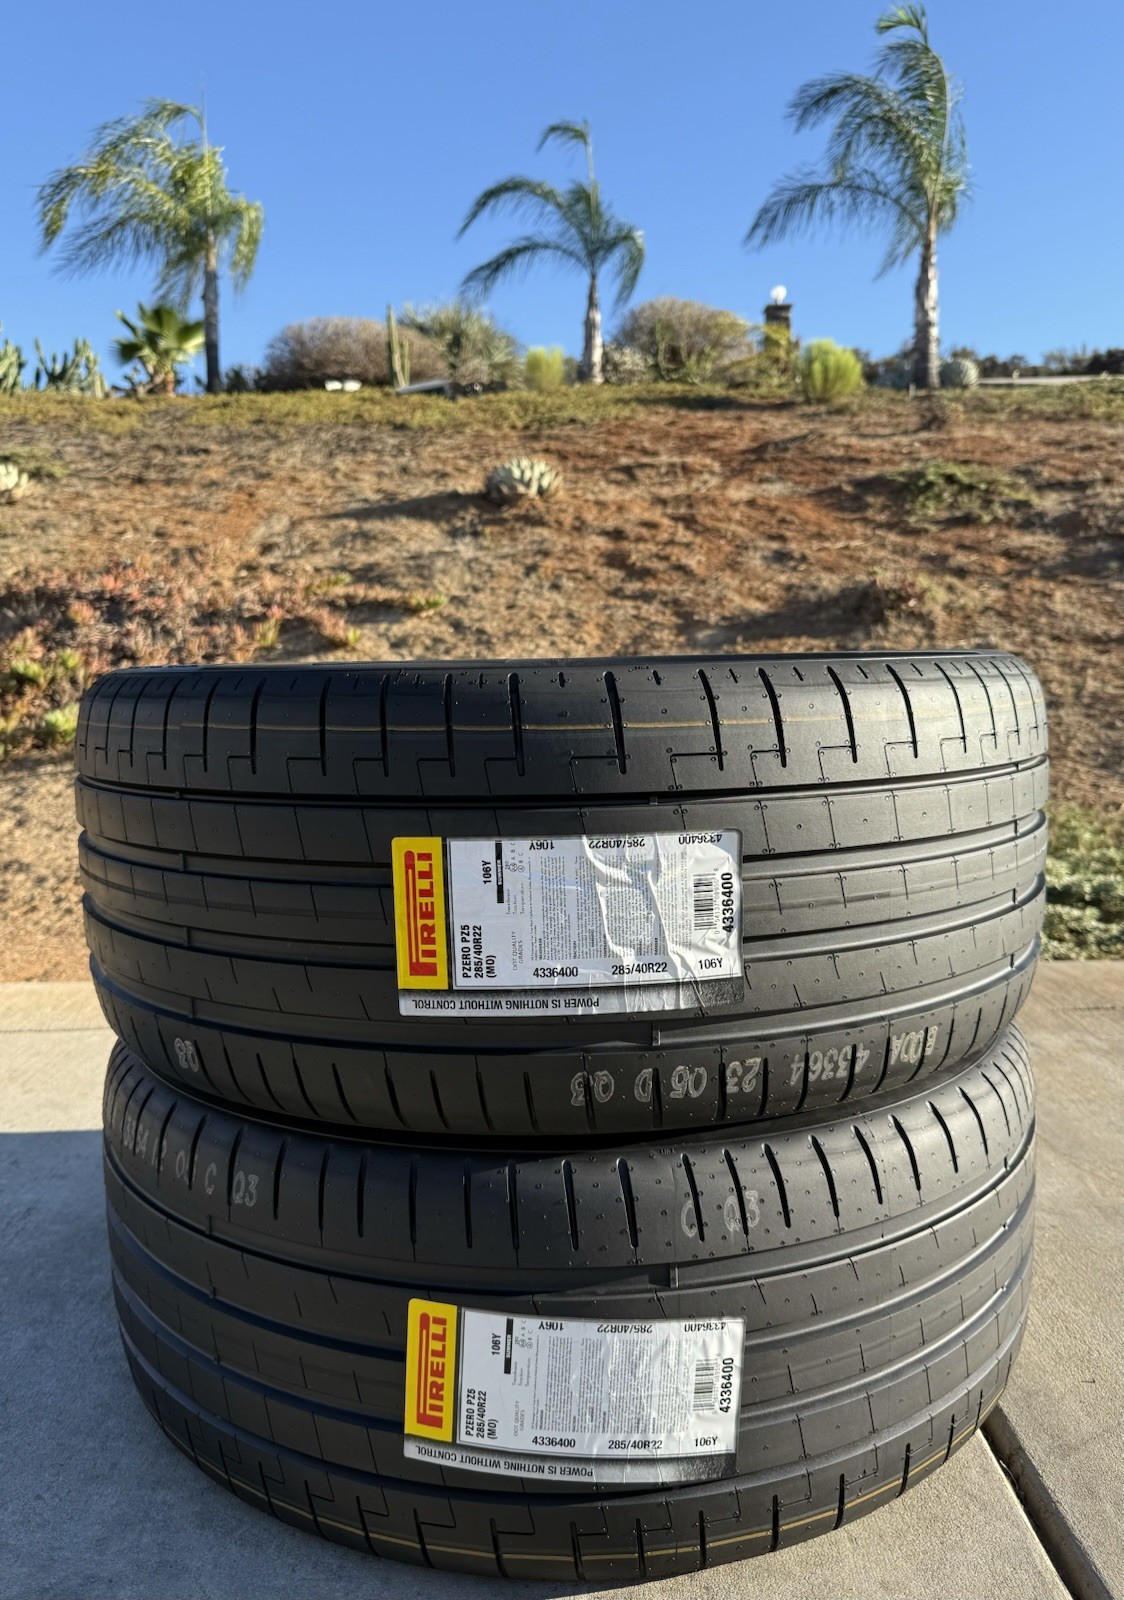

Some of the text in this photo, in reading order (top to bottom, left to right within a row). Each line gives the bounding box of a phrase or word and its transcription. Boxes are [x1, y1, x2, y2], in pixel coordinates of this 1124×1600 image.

[529, 840, 555, 850] 106Y
[482, 860, 492, 884] 106Y
[404, 850, 438, 977] PIRELLI
[720, 872, 734, 933] 4336400
[460, 924, 471, 978] PZERO PZ5
[472, 925, 483, 979] 285/40R22
[486, 954, 497, 978] (MO)
[533, 966, 579, 979] 4336400
[611, 962, 668, 975] 285/40R22
[698, 958, 723, 970] 106Y
[412, 998, 600, 1010] POWER IS NOTHING WITHOUT CONTROL
[538, 1321, 564, 1331] 106Y
[491, 1333, 501, 1356] 106Y
[416, 1312, 447, 1429] PIRELLI
[719, 1357, 734, 1413] 4336400
[465, 1388, 476, 1437] PZERO PZ5
[476, 1390, 487, 1439] 285/40R22
[487, 1418, 498, 1440] (MO)
[532, 1436, 576, 1448] 4336400
[608, 1438, 663, 1451] 285/40R22
[694, 1435, 718, 1447] 106Y
[415, 1445, 594, 1477] POWER IS NOTHING WITHOUT CONTROL
